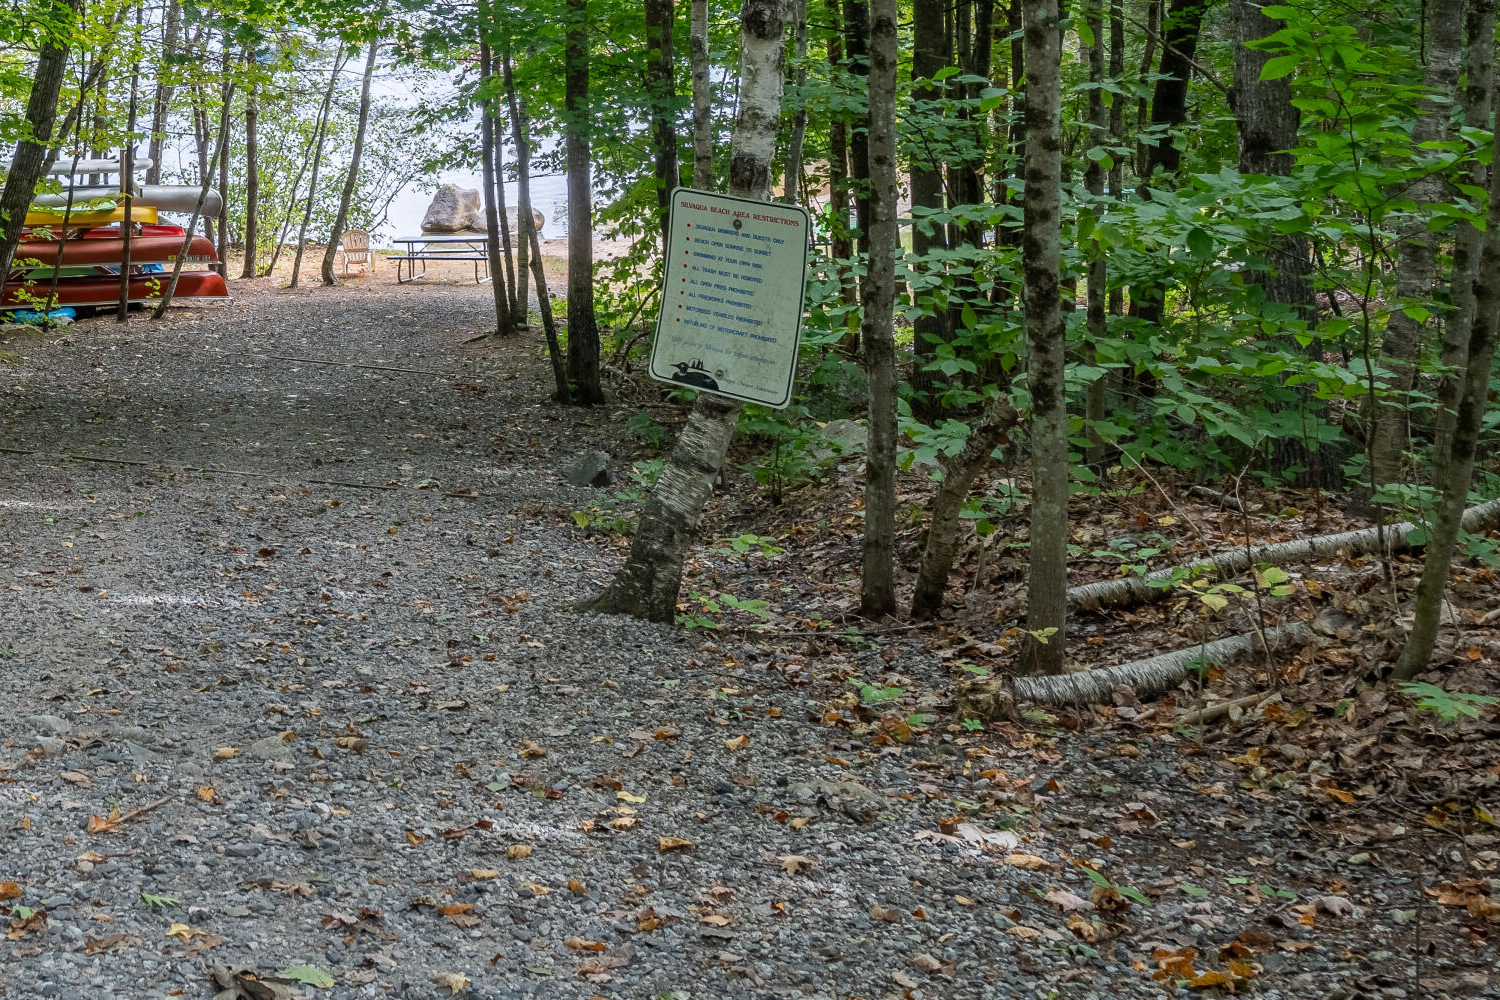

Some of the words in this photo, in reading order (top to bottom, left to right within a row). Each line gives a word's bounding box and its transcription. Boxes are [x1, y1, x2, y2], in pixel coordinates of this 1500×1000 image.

[681, 202, 708, 211] SILVAQUA
[710, 207, 730, 215] BEACH
[753, 214, 799, 226] RESTRICTIONS
[753, 248, 772, 256] SUNSET
[741, 275, 762, 283] REMOVED
[729, 287, 754, 296] PROHIBITED
[698, 294, 724, 303] FIREWORKS
